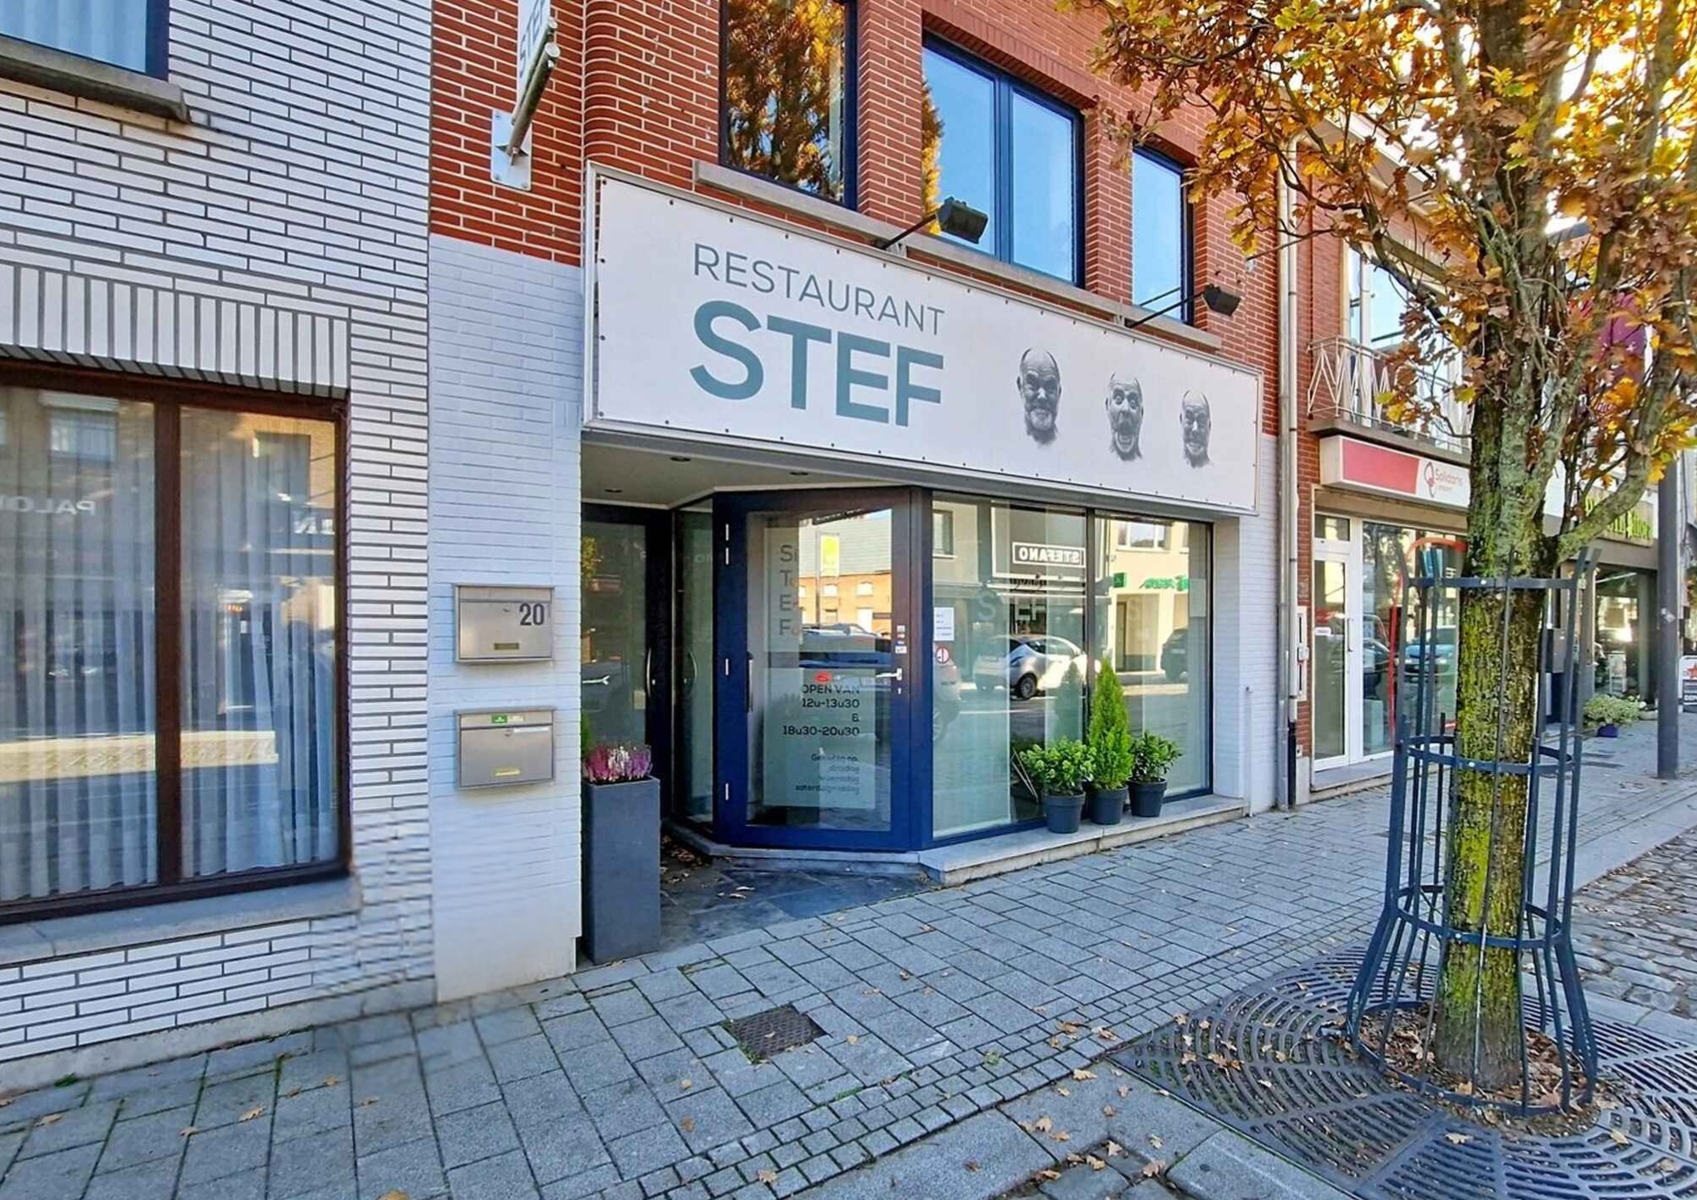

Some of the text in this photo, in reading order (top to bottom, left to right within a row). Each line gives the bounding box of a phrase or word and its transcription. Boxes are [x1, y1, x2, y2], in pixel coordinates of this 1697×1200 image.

[694, 243, 945, 336] RESTAURANT
[689, 299, 944, 427] STEF
[519, 602, 545, 626] 20
[802, 684, 832, 693] OPEN
[802, 698, 860, 708] 12u-13u30
[783, 725, 860, 736] 18u30-20u30
